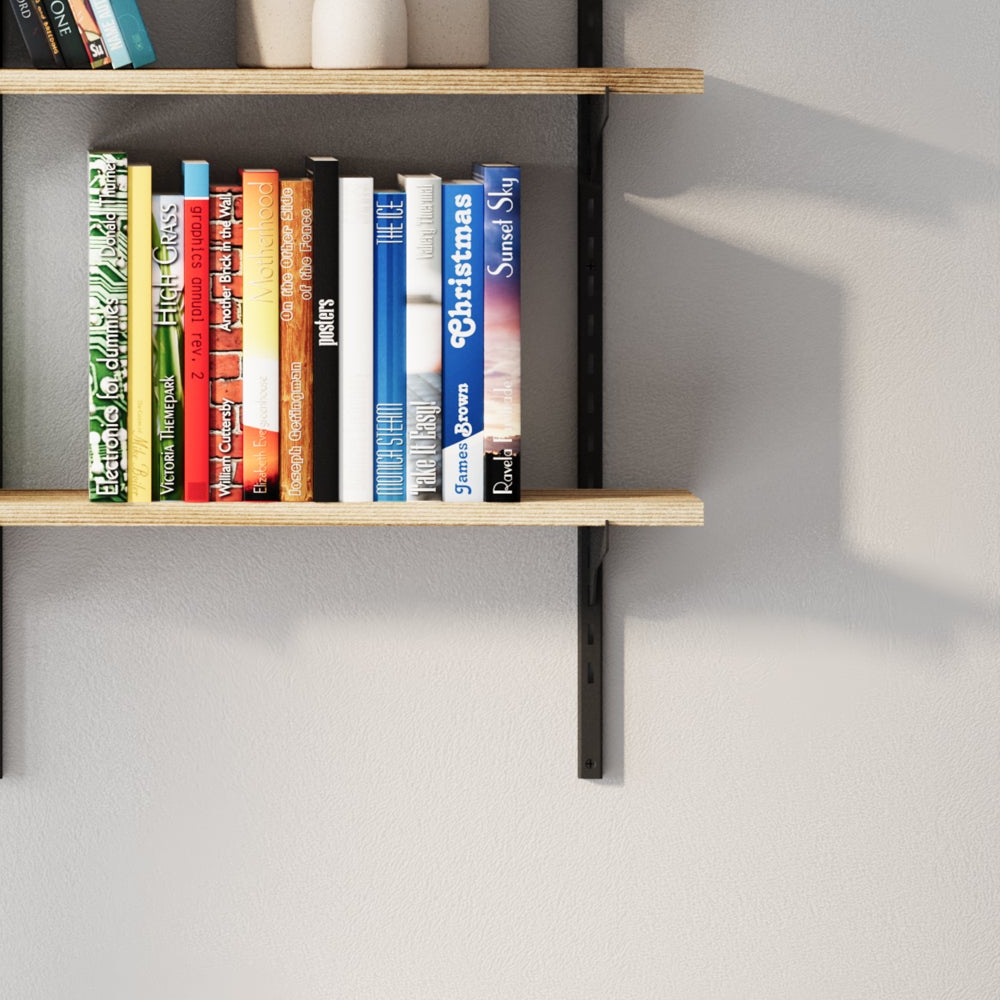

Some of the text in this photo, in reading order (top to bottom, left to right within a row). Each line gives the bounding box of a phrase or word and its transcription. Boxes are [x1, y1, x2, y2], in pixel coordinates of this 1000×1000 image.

[99, 213, 116, 258] Donald
[218, 220, 232, 238] the
[218, 242, 232, 251] in
[218, 254, 232, 283] Brick
[247, 182, 274, 303] Motherhood
[280, 187, 294, 322] On the Other Side
[300, 208, 313, 300] of the Fence
[376, 200, 404, 245] THE ICE
[487, 177, 519, 279] Sunset Sky
[191, 206, 204, 380] graphics annual rev. 2
[218, 285, 232, 331] Another
[447, 193, 476, 349] Christmas
[314, 299, 338, 346] posters
[97, 298, 119, 496] Electronics for dummies
[455, 382, 472, 495] James Brown
[218, 398, 234, 497] William Cuttersby
[253, 450, 268, 494] Elizabeth
[288, 446, 304, 496] Joseph
[376, 403, 404, 496] MONICA STEAM
[409, 401, 441, 496] Take It Easy!
[493, 449, 513, 495] Ravela
